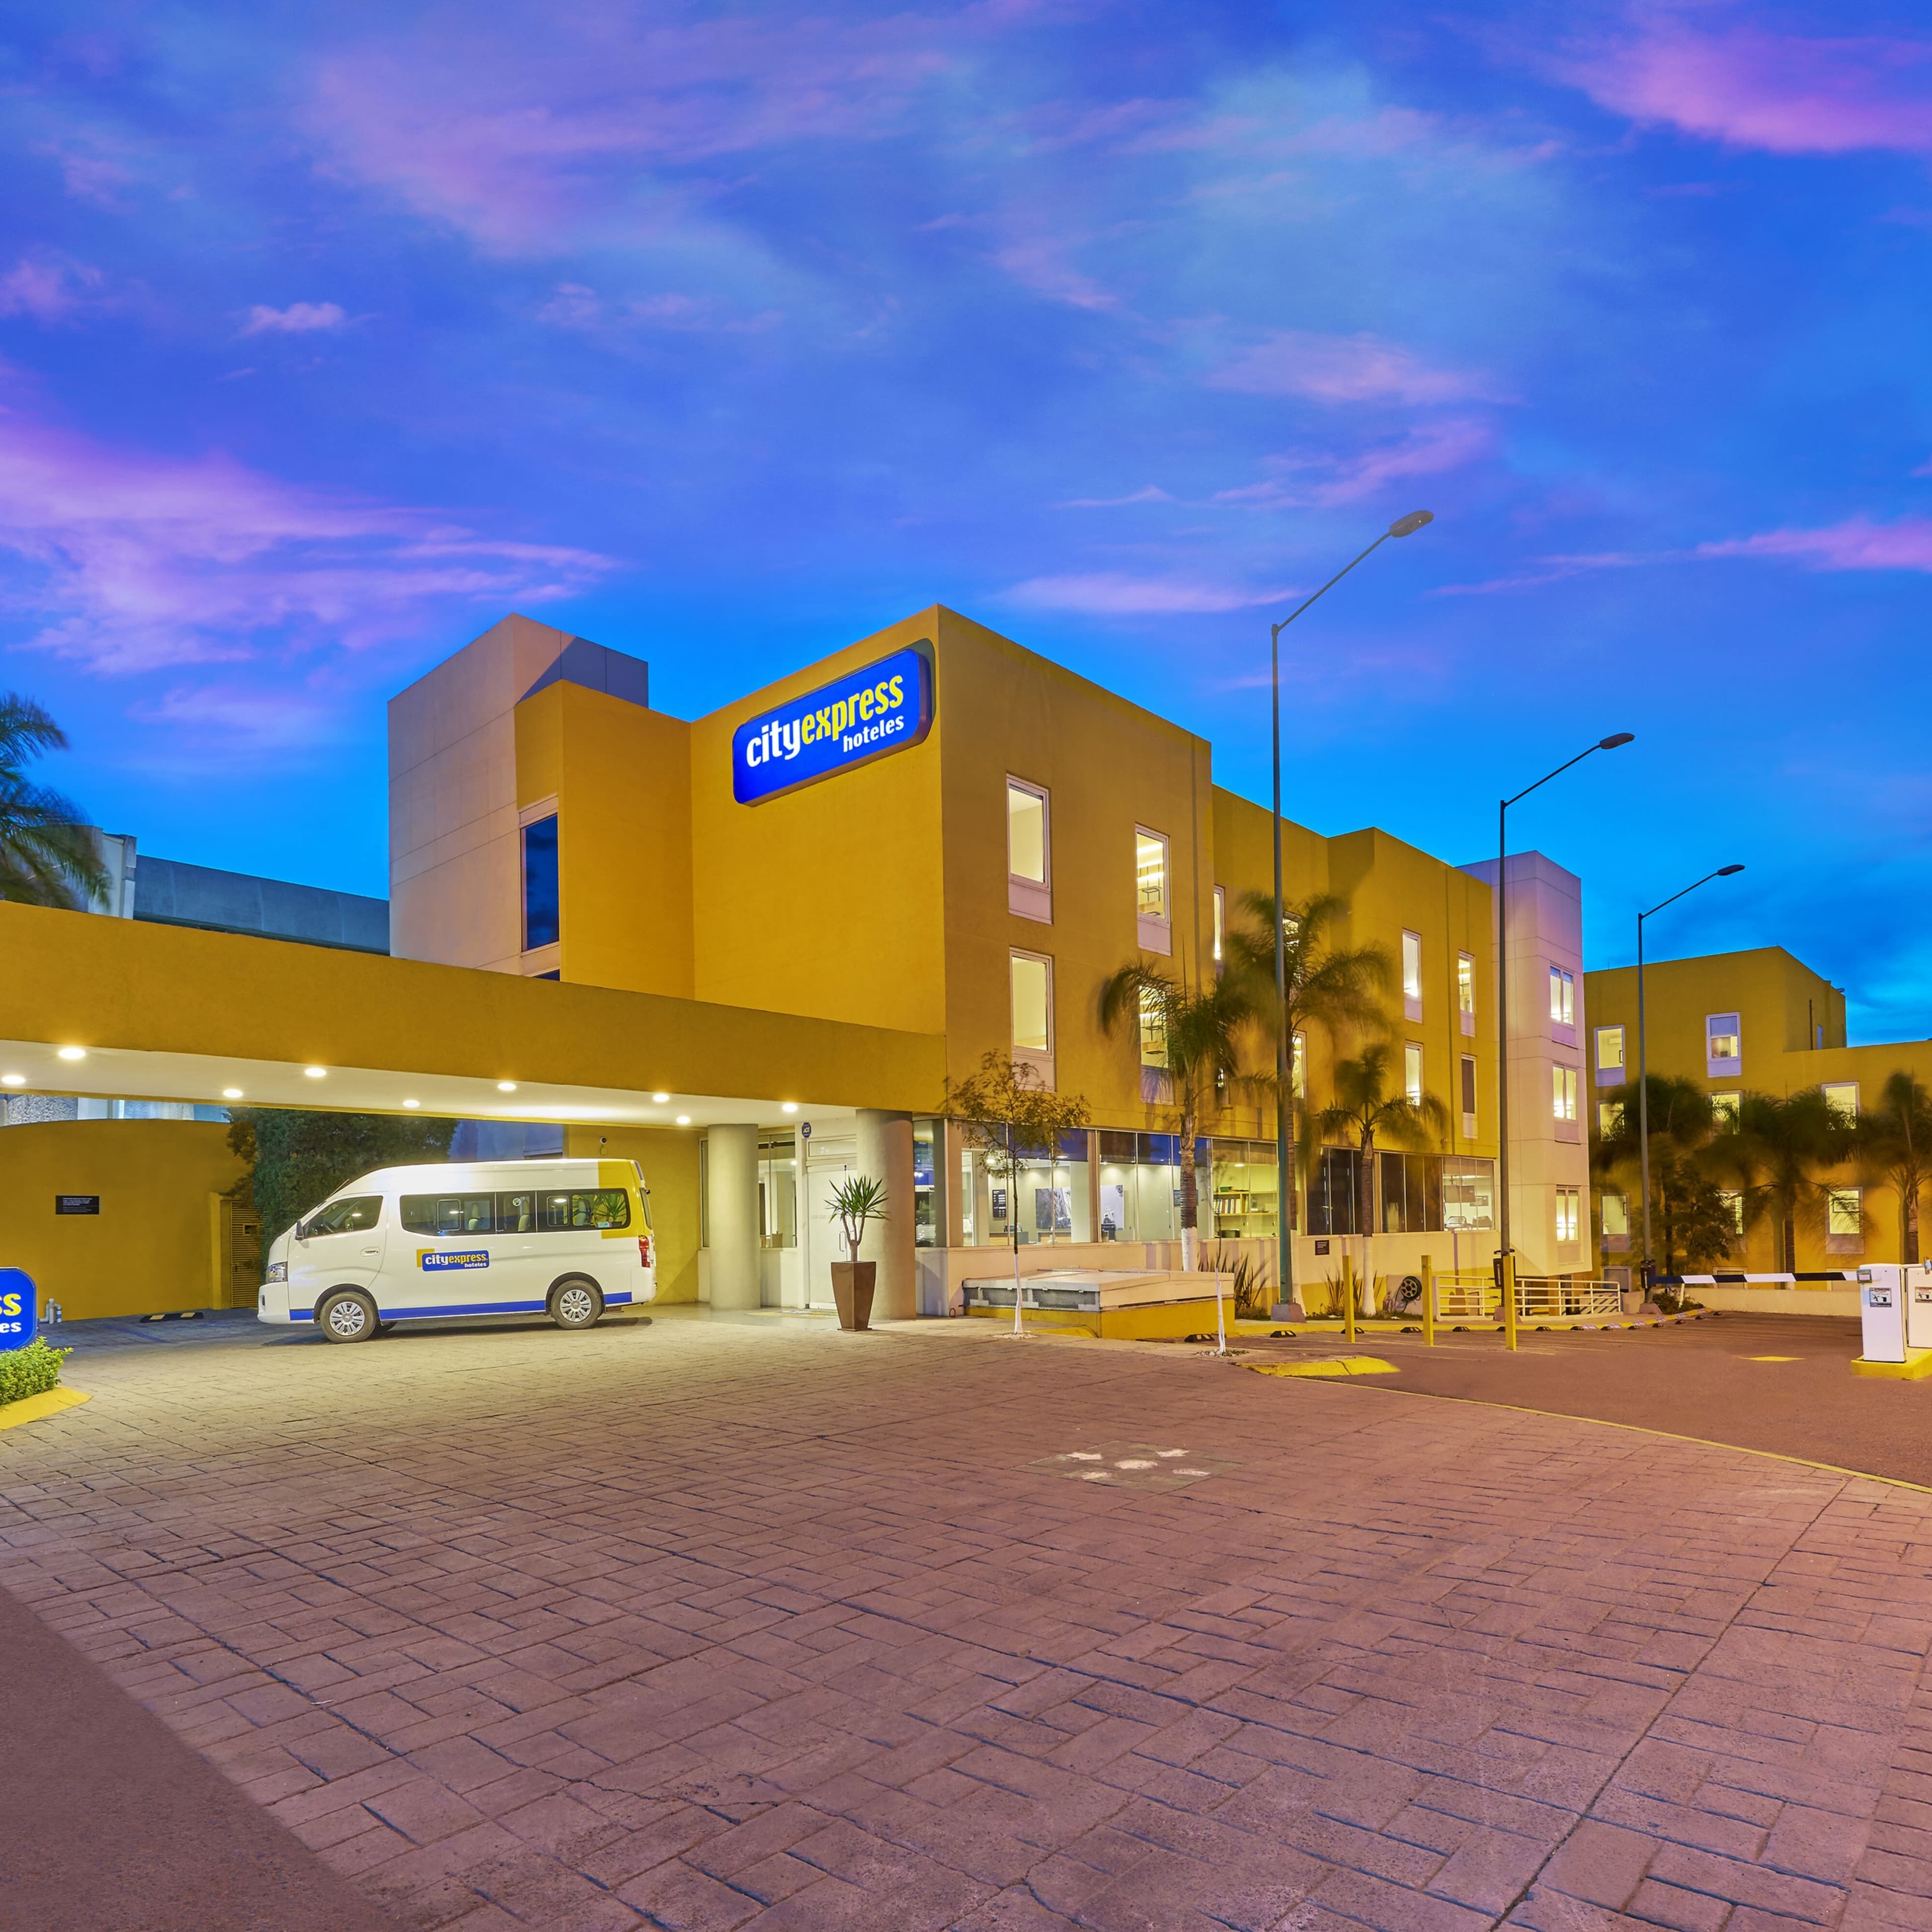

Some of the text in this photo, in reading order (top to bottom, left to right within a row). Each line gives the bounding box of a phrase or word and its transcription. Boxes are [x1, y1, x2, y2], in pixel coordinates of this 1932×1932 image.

[746, 675, 904, 767] cityexpress
[843, 715, 904, 753] hoteles
[425, 1253, 487, 1266] cityexpress
[0, 1293, 22, 1316] s
